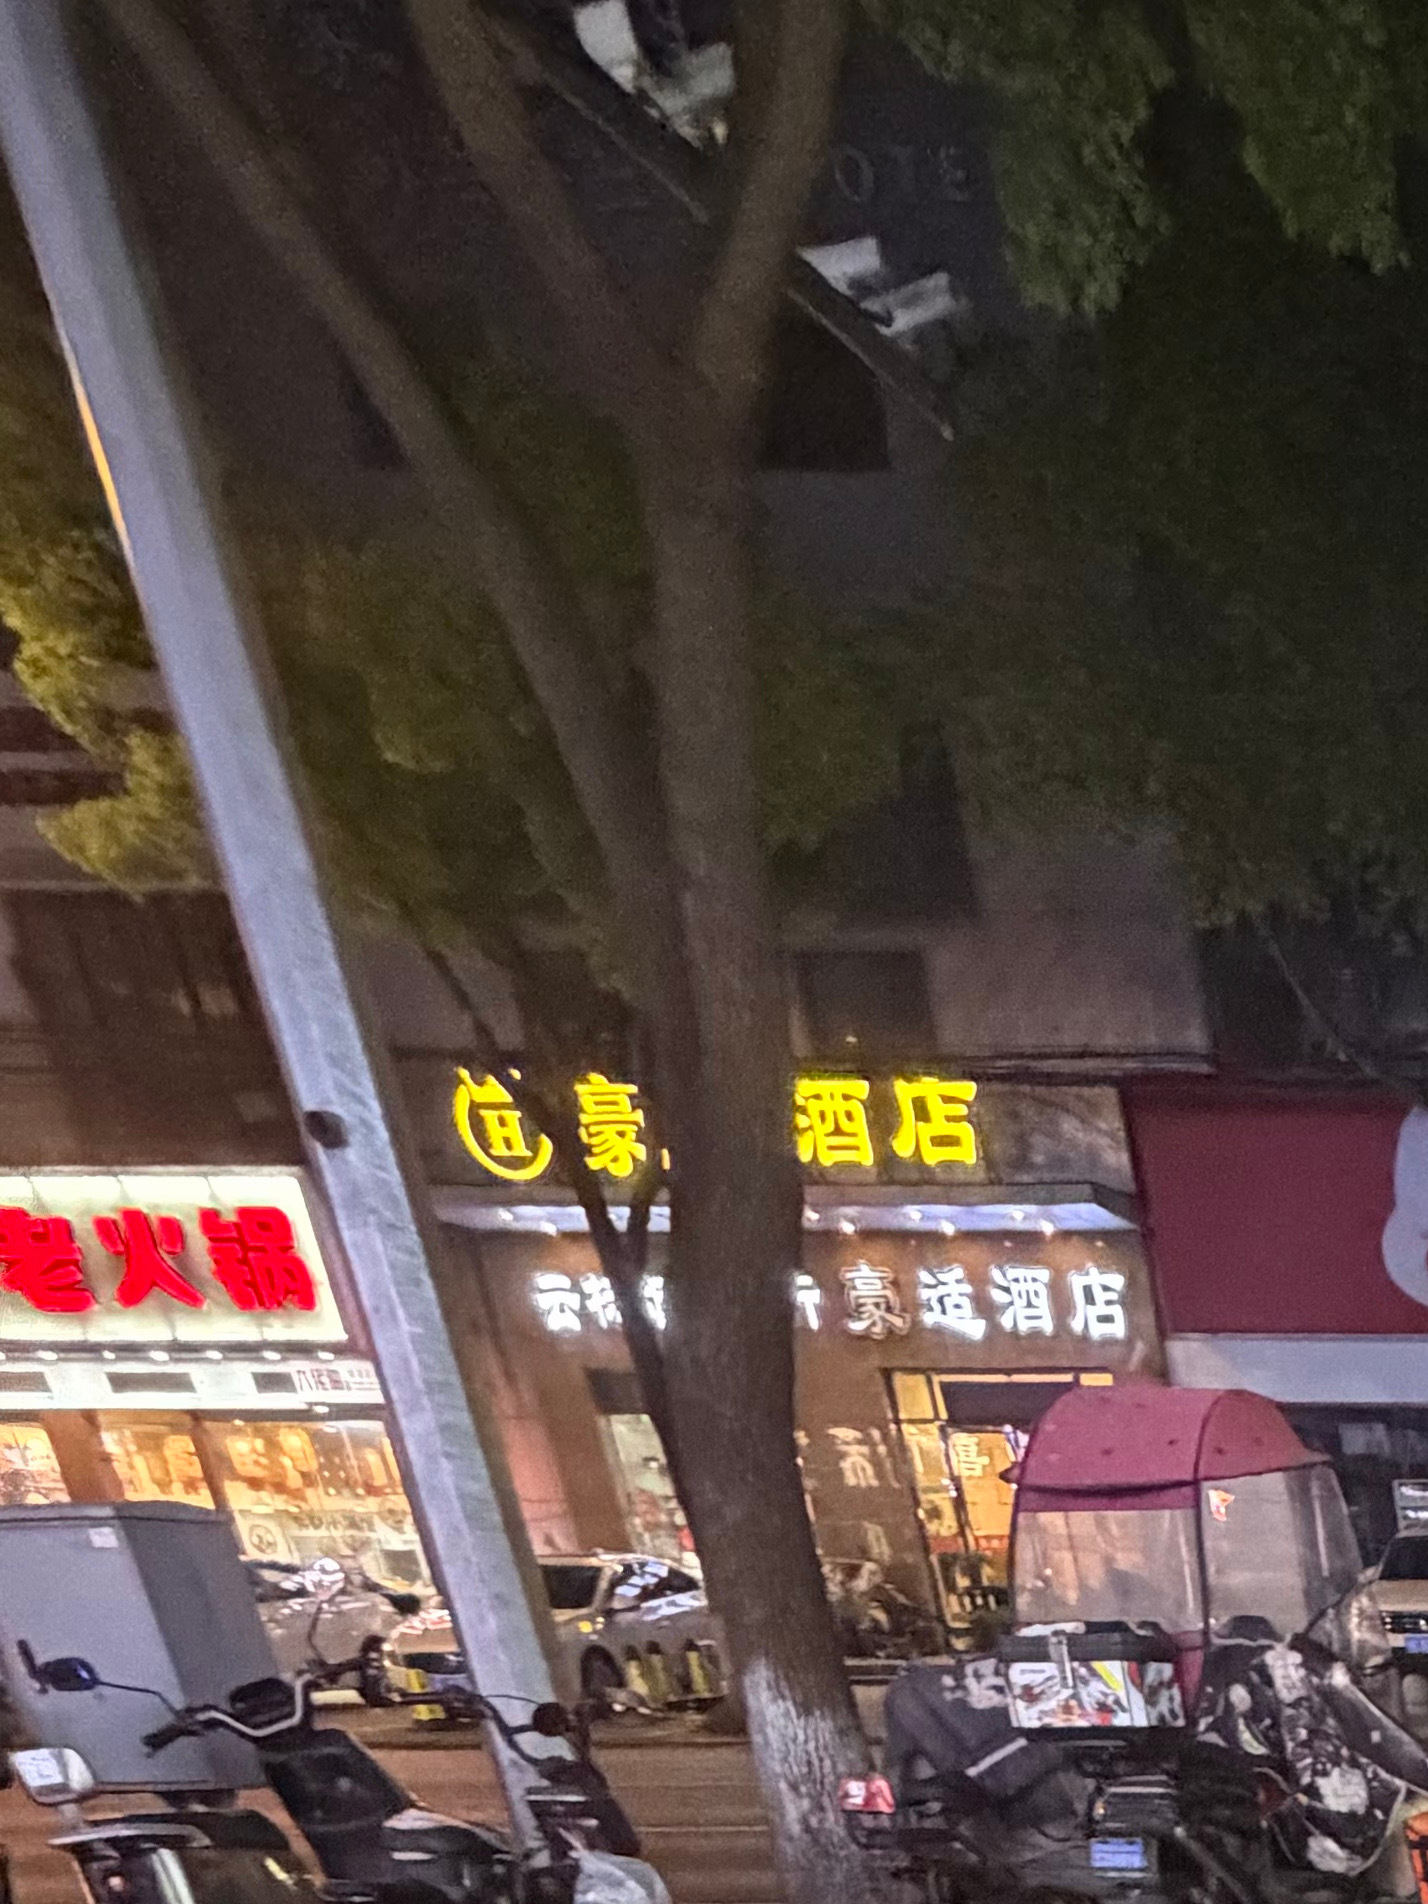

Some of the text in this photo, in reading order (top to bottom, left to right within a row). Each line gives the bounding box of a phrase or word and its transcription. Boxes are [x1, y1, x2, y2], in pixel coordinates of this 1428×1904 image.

[574, 1072, 978, 1176] 豪酒店
[0, 1206, 317, 1312] 老火锅
